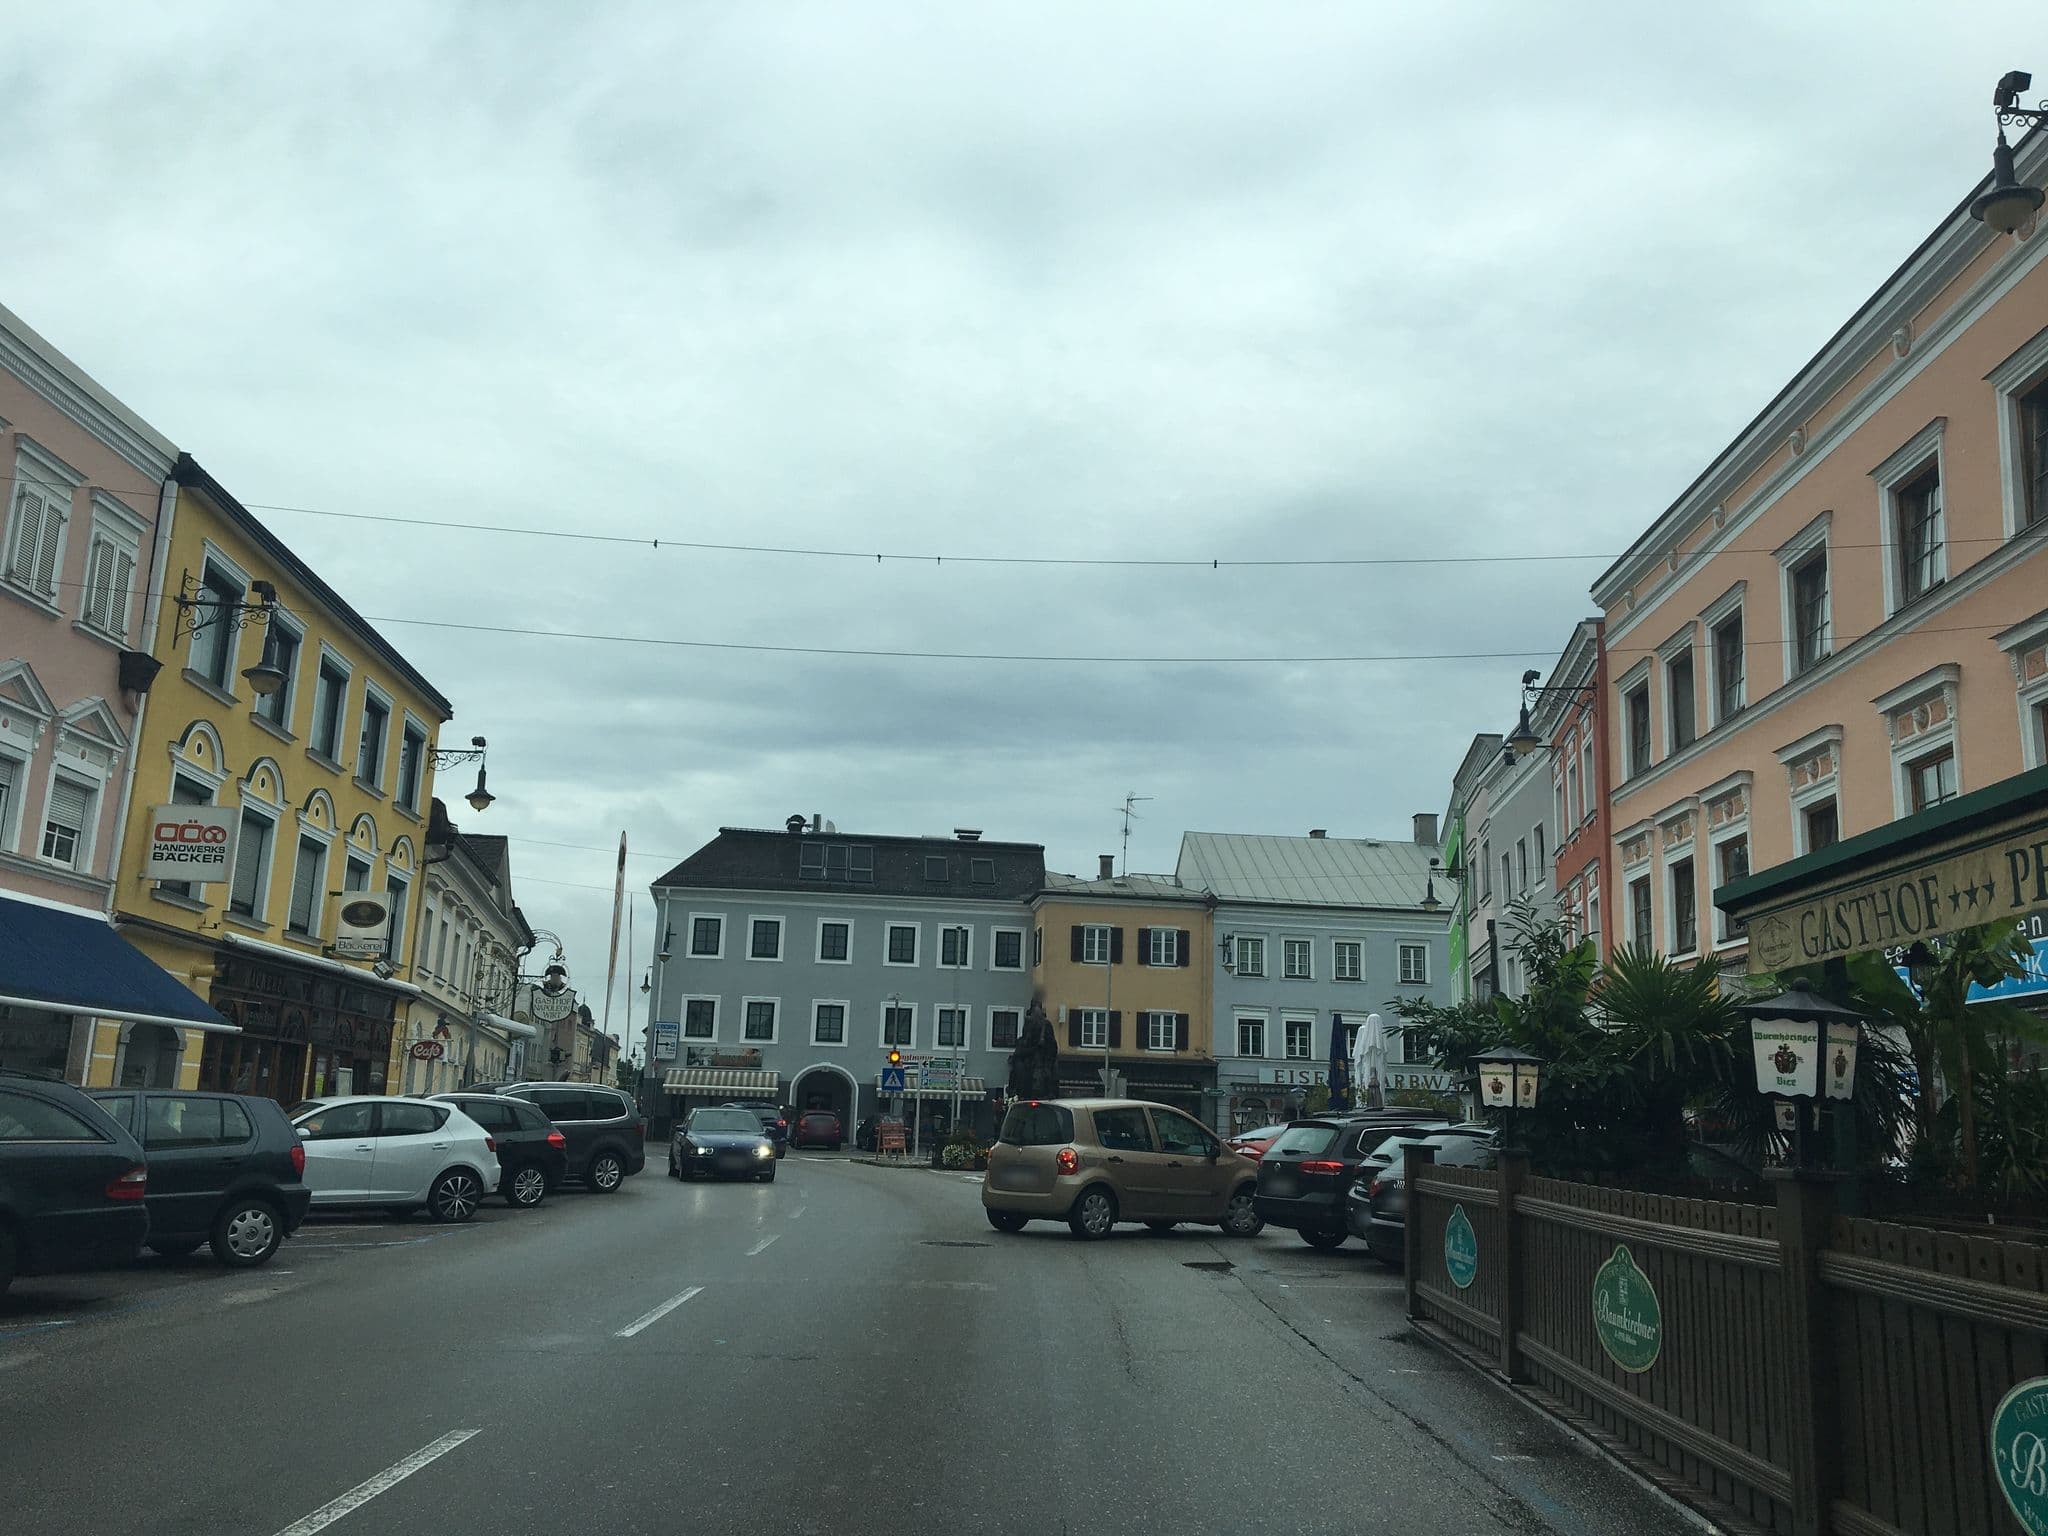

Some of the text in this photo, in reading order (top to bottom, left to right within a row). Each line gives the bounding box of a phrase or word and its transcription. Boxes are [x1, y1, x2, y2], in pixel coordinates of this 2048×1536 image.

[153, 843, 226, 854] HANDWERKS
[152, 852, 225, 863] BÄCKER
[1800, 874, 1941, 957] GASTHOF
[535, 997, 572, 1005] GASTHOF
[534, 1004, 570, 1012] NAPOLEON
[543, 1011, 561, 1019] WIRT
[413, 1044, 441, 1060] Café
[1274, 1069, 1329, 1085] EISE
[1776, 1076, 1797, 1087] Bier
